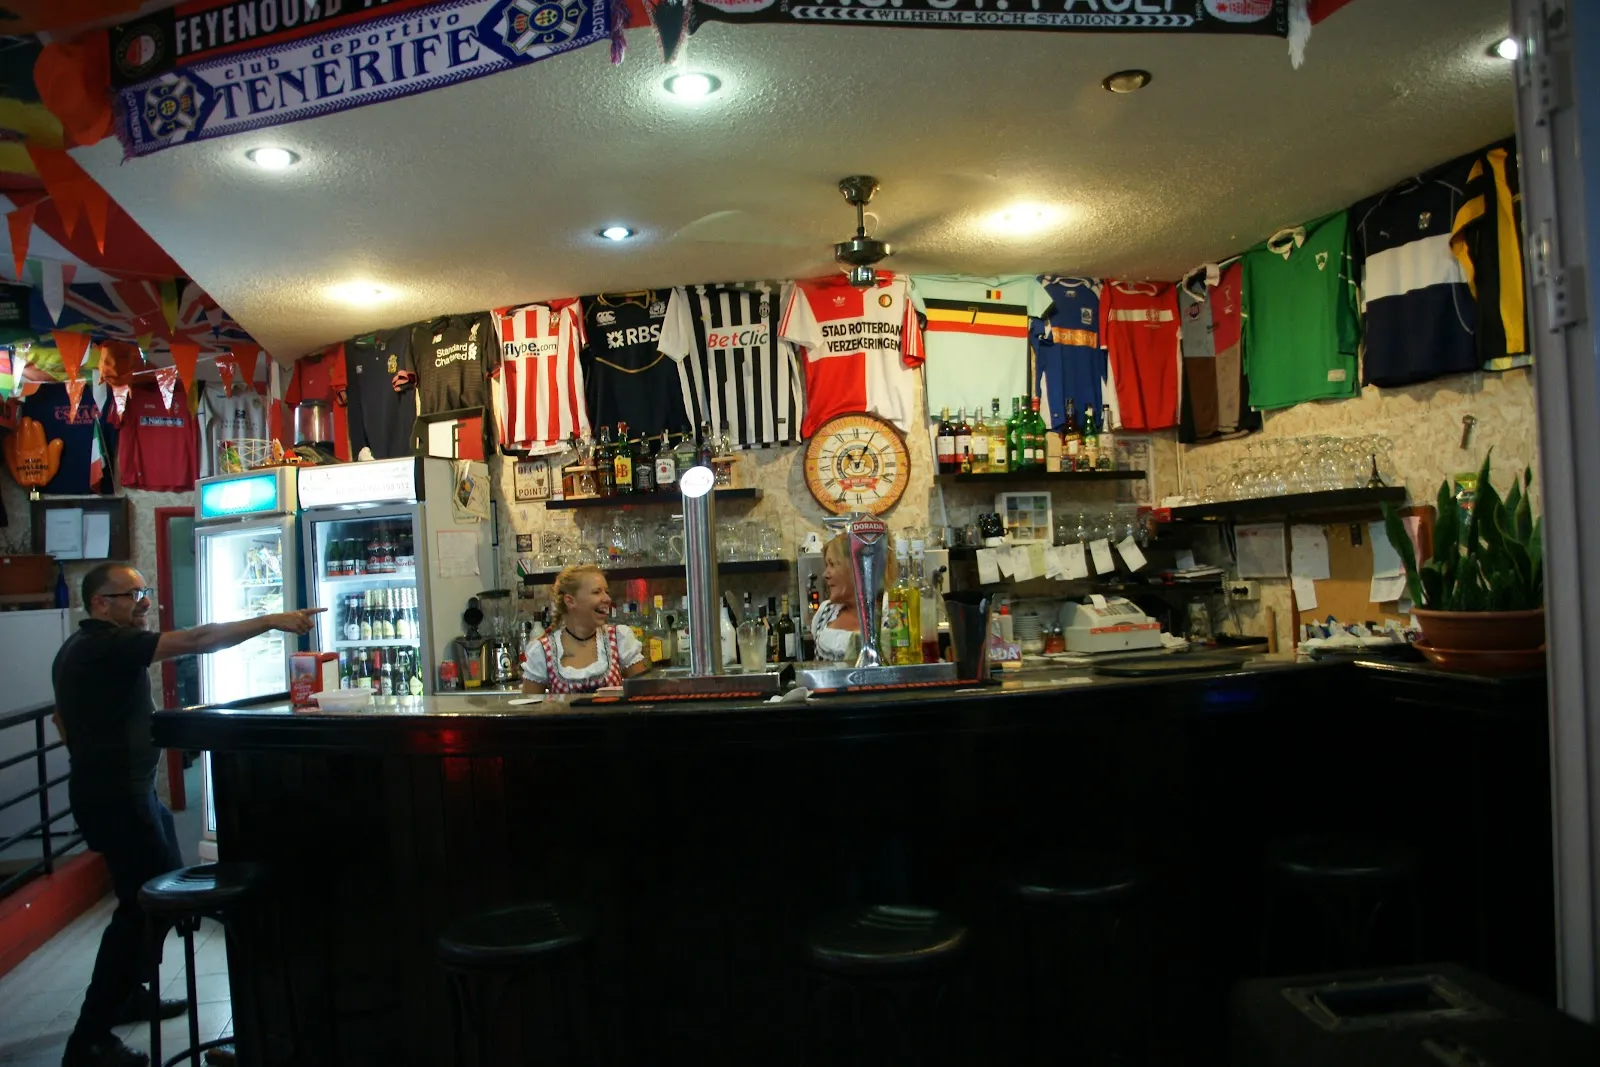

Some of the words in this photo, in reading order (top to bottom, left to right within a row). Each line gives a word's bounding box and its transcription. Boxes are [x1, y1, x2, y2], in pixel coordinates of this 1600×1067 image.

[876, 11, 1118, 26] WILHELM-KOCH-STADION
[224, 56, 280, 81] club
[312, 13, 461, 60] deportivo
[213, 24, 482, 120] TENERIFE
[625, 324, 662, 346] RBS
[821, 324, 847, 337] STAD
[848, 321, 903, 336] ROTTERDAM
[707, 327, 769, 348] BetClic
[826, 338, 902, 352] VERZEKERINGEN
[436, 342, 468, 358] Standard
[503, 340, 558, 358] flybe.com
[434, 352, 468, 368] Chartered
[518, 486, 548, 497] POINT?
[853, 522, 884, 531] DORADA
